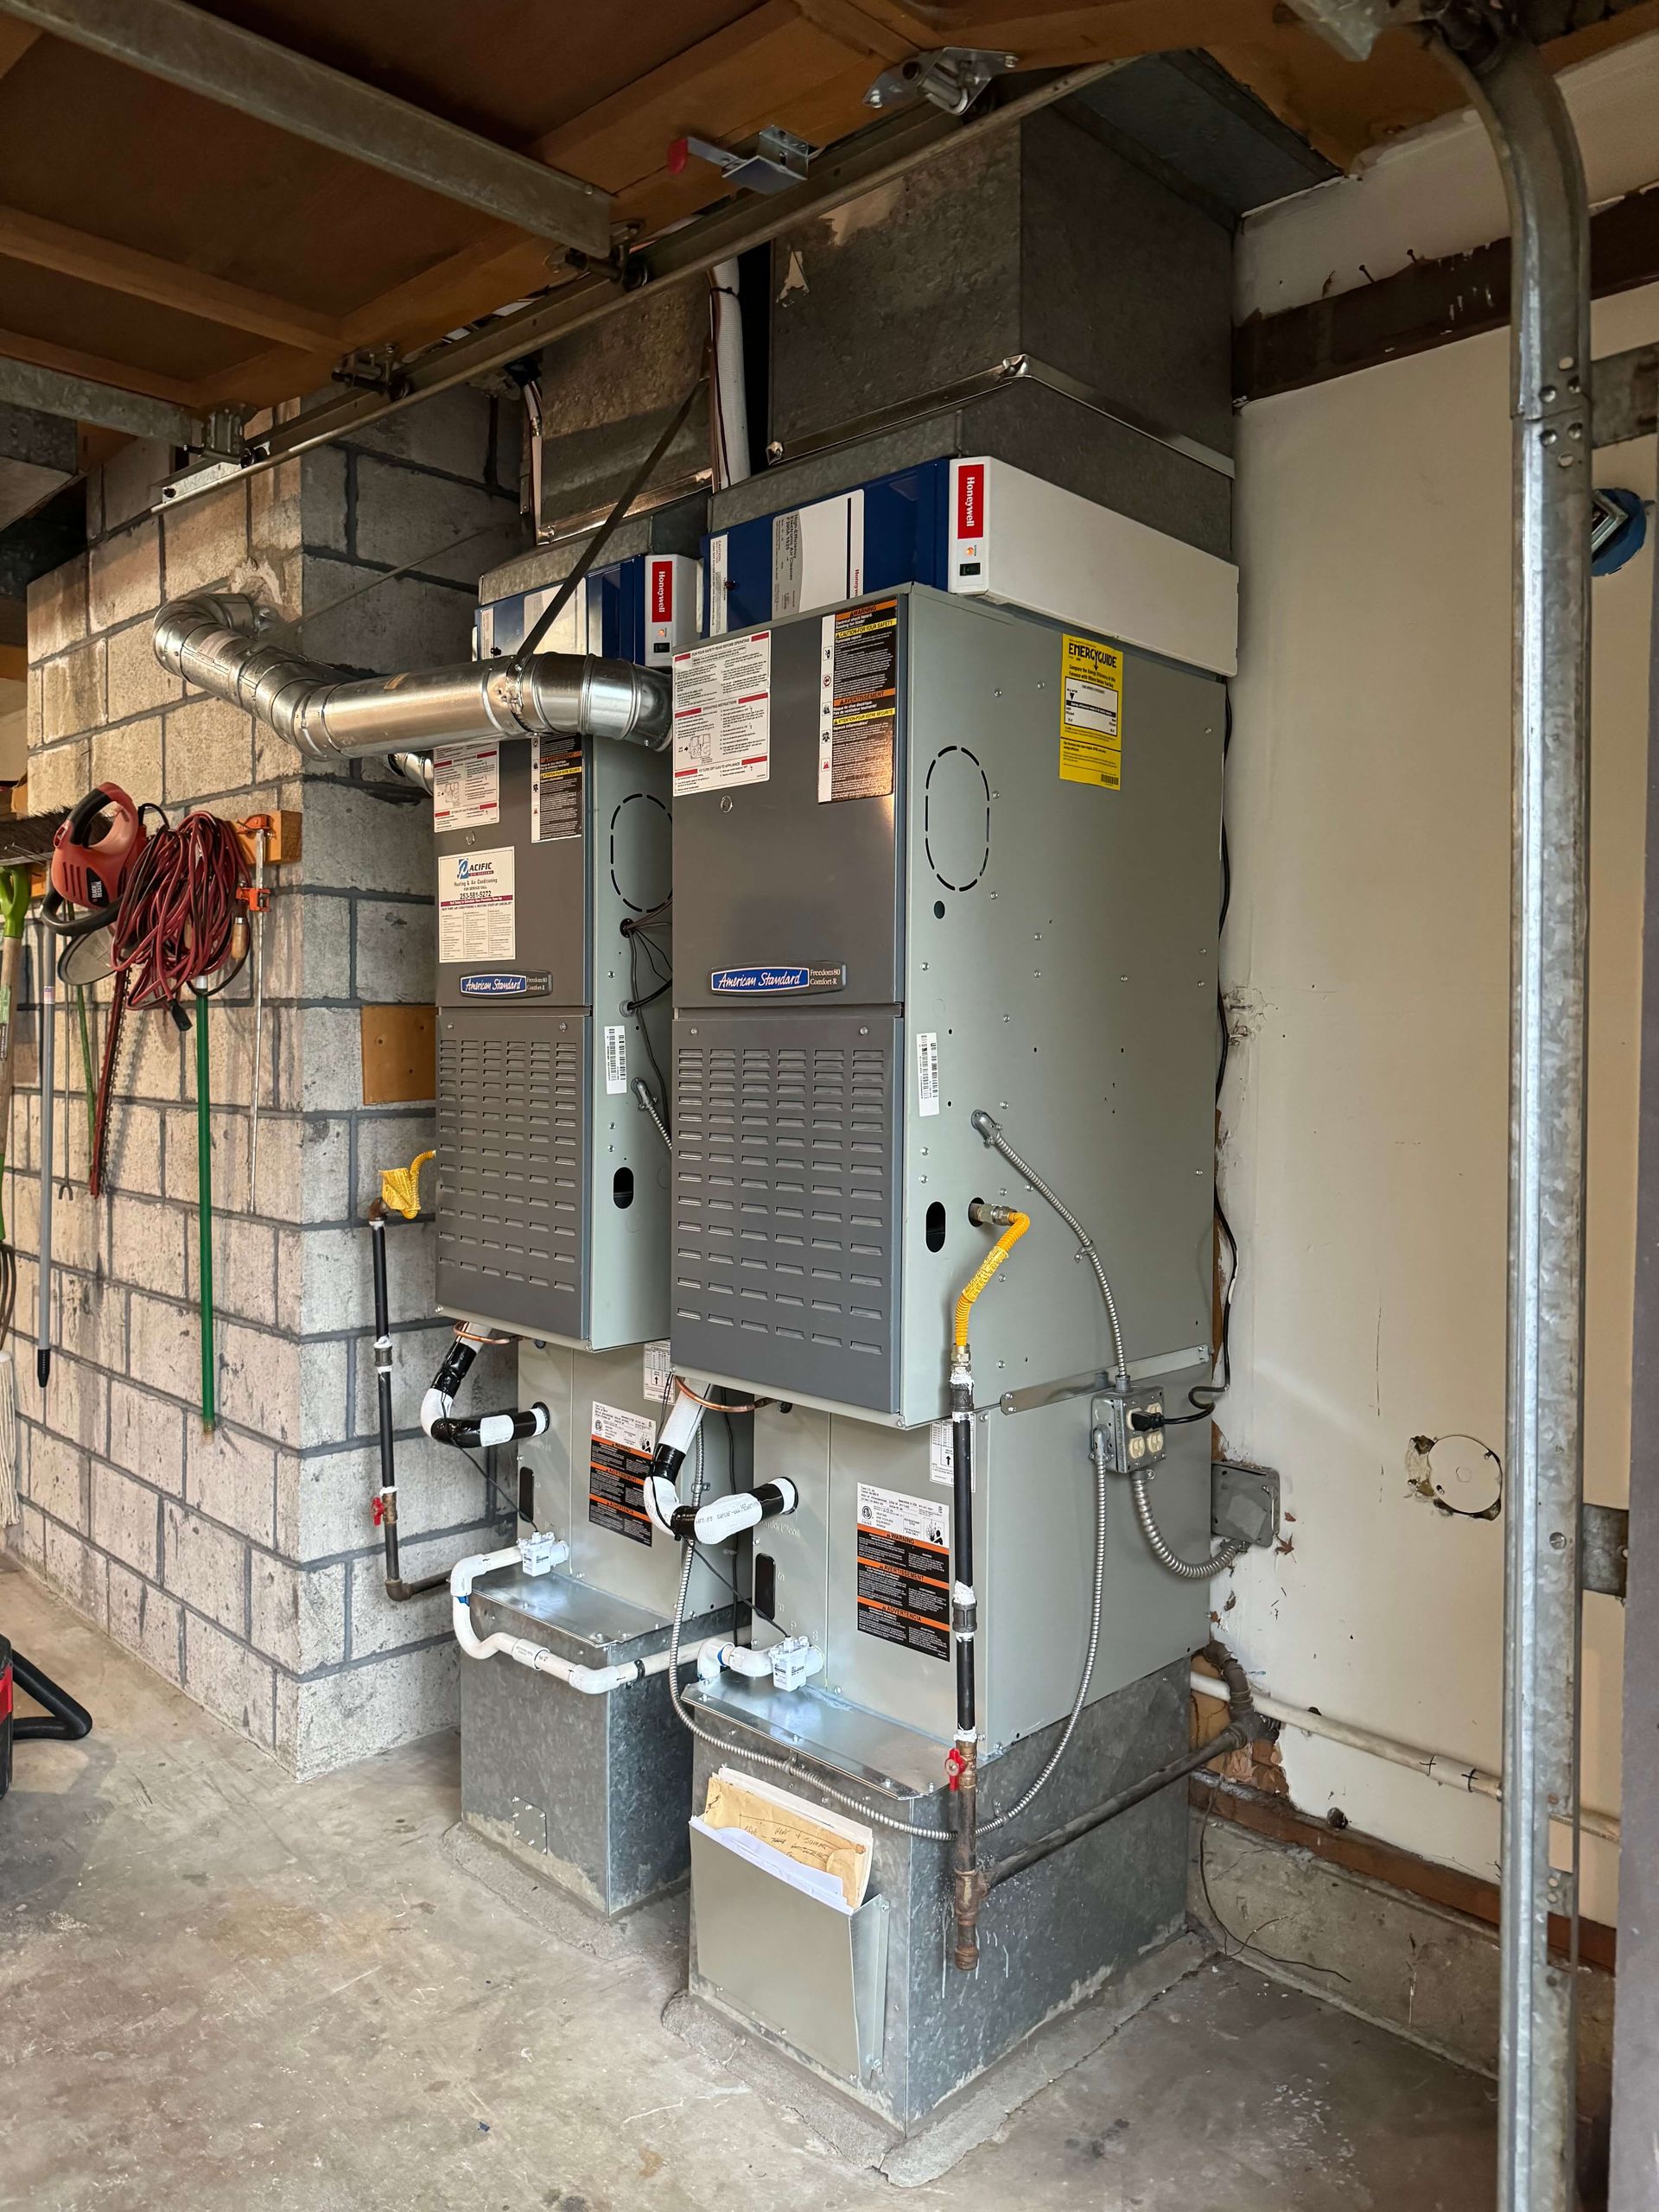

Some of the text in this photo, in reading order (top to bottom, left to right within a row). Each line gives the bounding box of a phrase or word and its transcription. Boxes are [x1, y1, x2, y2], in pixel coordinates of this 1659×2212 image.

[965, 476, 975, 527] Honeywell
[658, 570, 666, 613] Honeywell
[1069, 643, 1116, 668] ENERGYGUIDE
[466, 977, 522, 991] American Standard
[718, 970, 802, 988] American Standard
[892, 1532, 914, 1544] WARNING
[885, 1564, 924, 1581] AVERTISSEMENT
[887, 1606, 922, 1621] ADVERTENCIA
